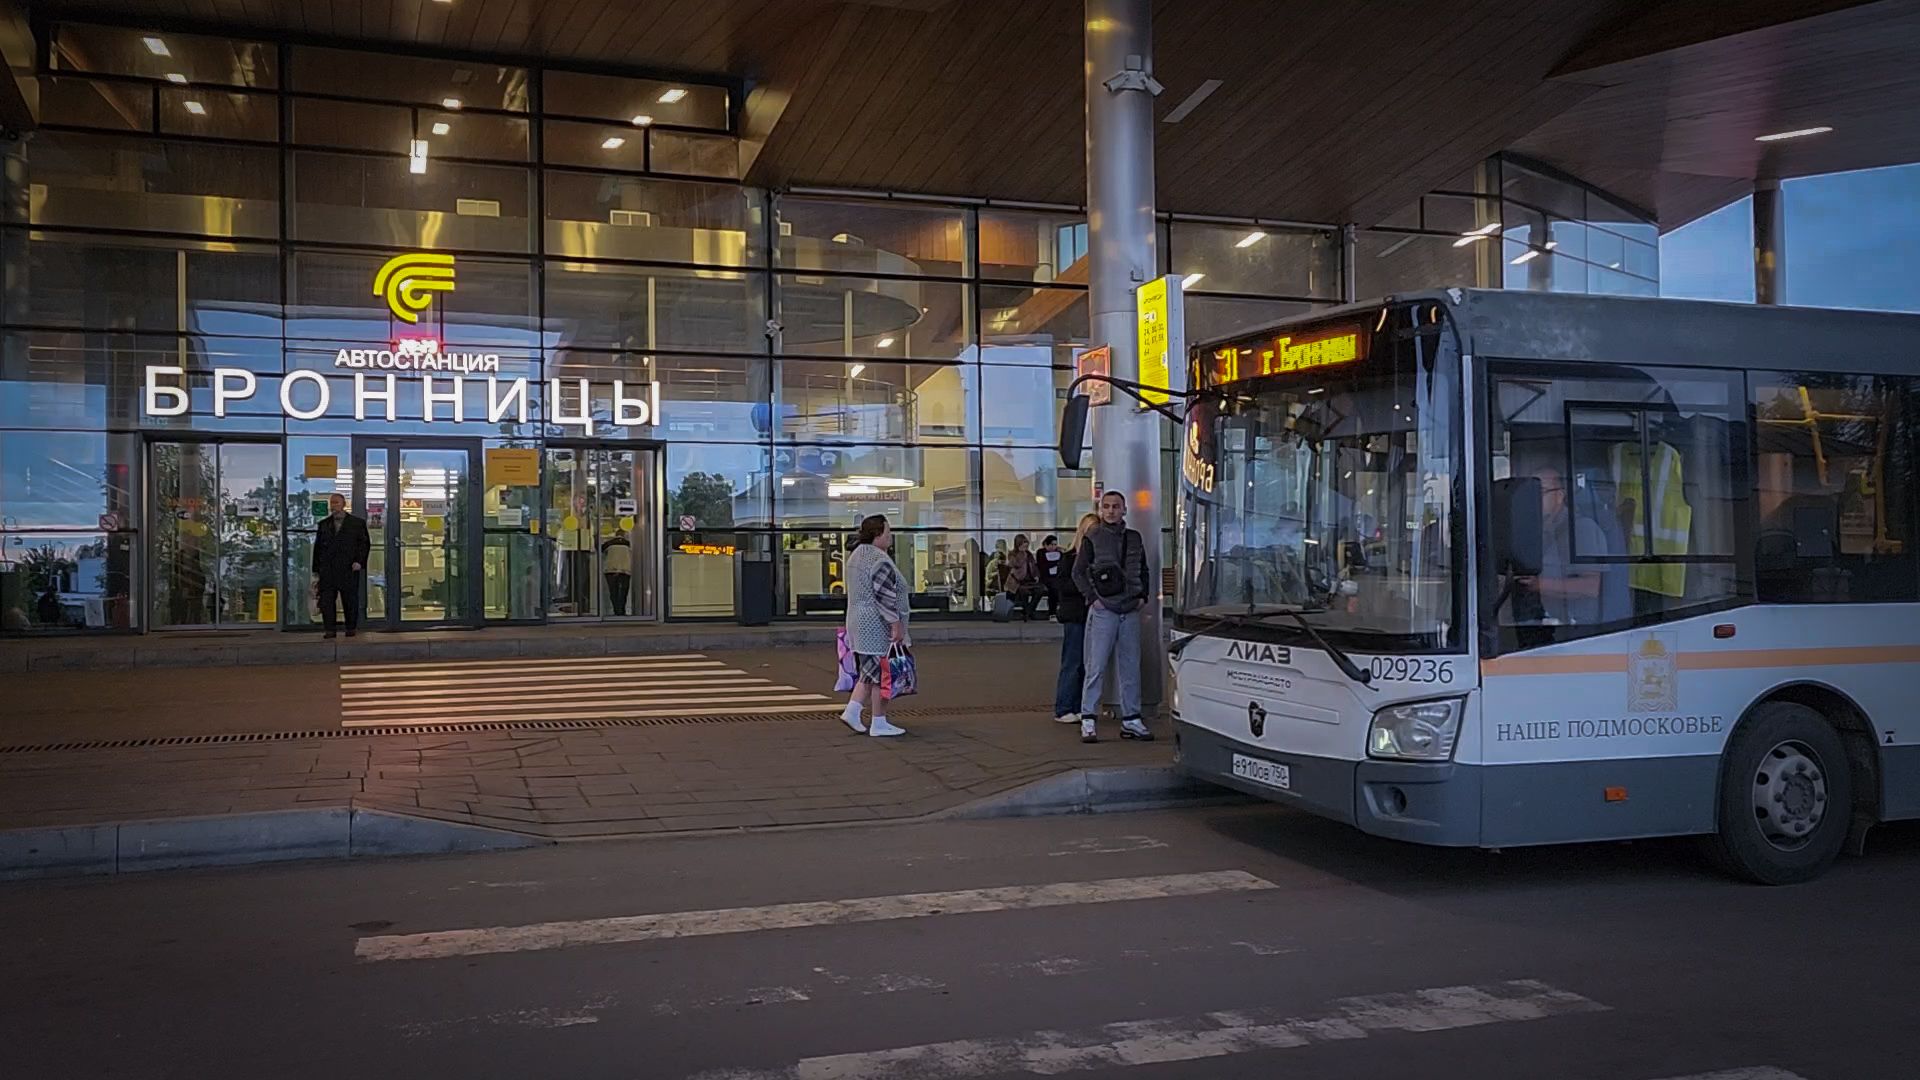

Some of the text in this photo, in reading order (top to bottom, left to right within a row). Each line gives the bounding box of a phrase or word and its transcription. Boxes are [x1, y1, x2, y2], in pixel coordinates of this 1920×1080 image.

[335, 349, 499, 375] АВТОСТАНЦИЯ
[1215, 347, 1239, 383] 31
[145, 365, 660, 436] БРОННИЦЫ
[1226, 640, 1291, 665] ЛИАЗ
[1371, 656, 1453, 684] 029236
[1496, 715, 1723, 742] НАШЕ ПОДМОСКОВЬЕ
